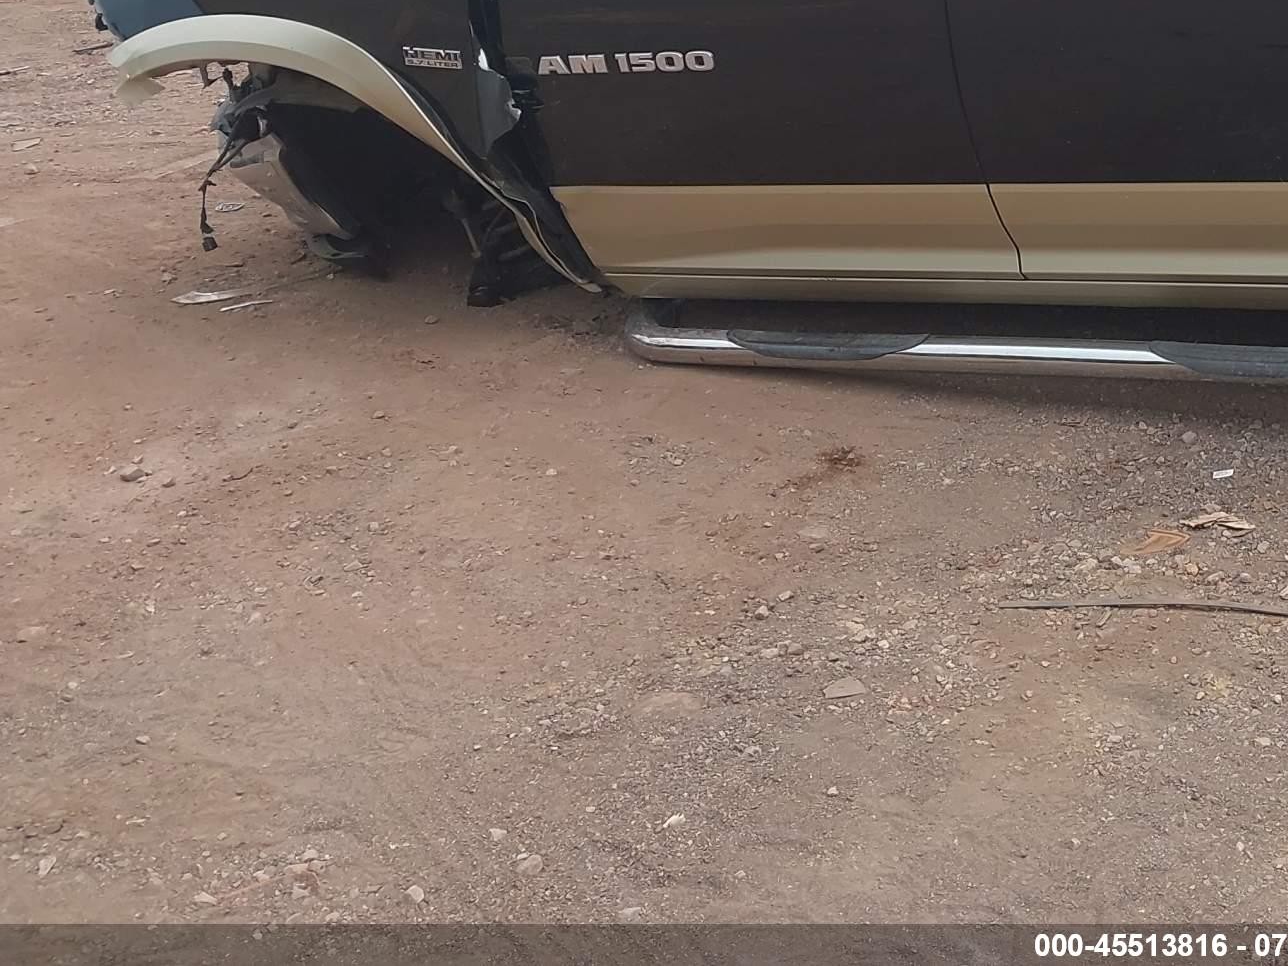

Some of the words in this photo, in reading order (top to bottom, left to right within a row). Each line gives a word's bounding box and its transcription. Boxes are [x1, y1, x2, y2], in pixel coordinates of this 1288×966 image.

[402, 46, 461, 60] HEMI
[427, 60, 460, 68] LITER
[538, 54, 608, 75] AM
[614, 50, 715, 73] 1500
